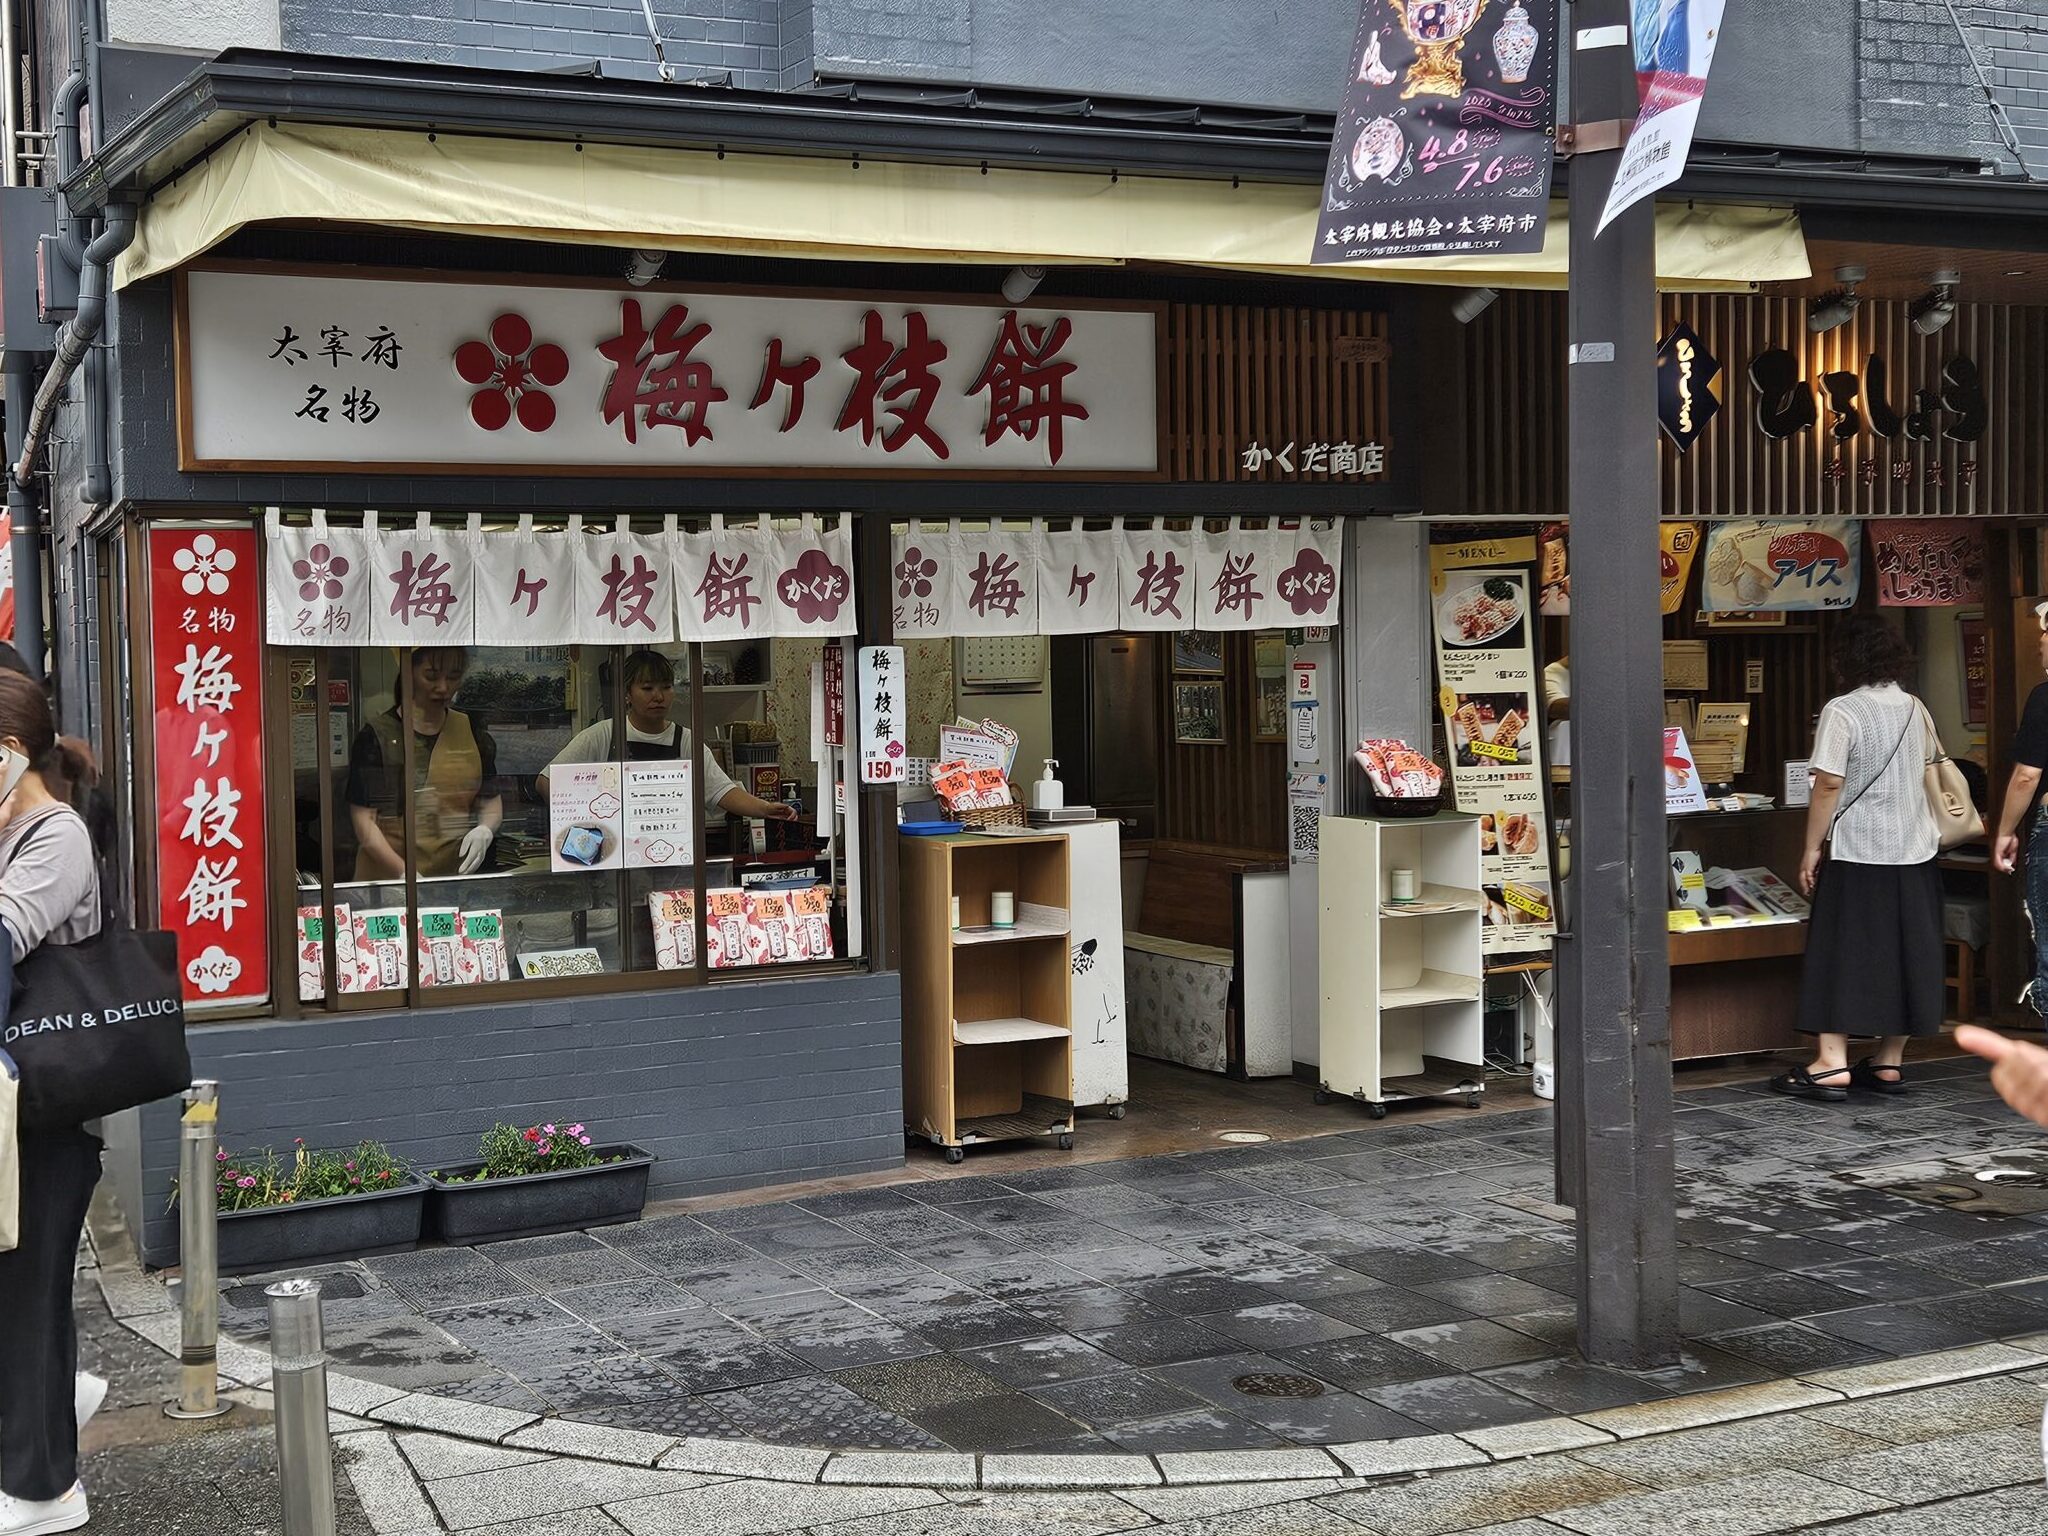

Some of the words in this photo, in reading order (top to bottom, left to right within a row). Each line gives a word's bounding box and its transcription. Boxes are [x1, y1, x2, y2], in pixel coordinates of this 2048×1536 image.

[1418, 128, 1468, 161] 4.8
[1455, 155, 1504, 191] 7.6
[268, 325, 403, 370] 太宰府
[295, 384, 381, 424] 名物
[1242, 440, 1385, 476] かくだ商店
[786, 574, 843, 602] かくだ
[1284, 572, 1332, 597] かくだ
[1773, 557, 1843, 588] アイス
[178, 607, 236, 635] 名物
[292, 604, 351, 637] 名物
[893, 601, 940, 630] 名物
[867, 761, 903, 779] 150円
[191, 959, 235, 980] かくだ
[5, 1013, 73, 1043] DEAN
[81, 1012, 97, 1028] &
